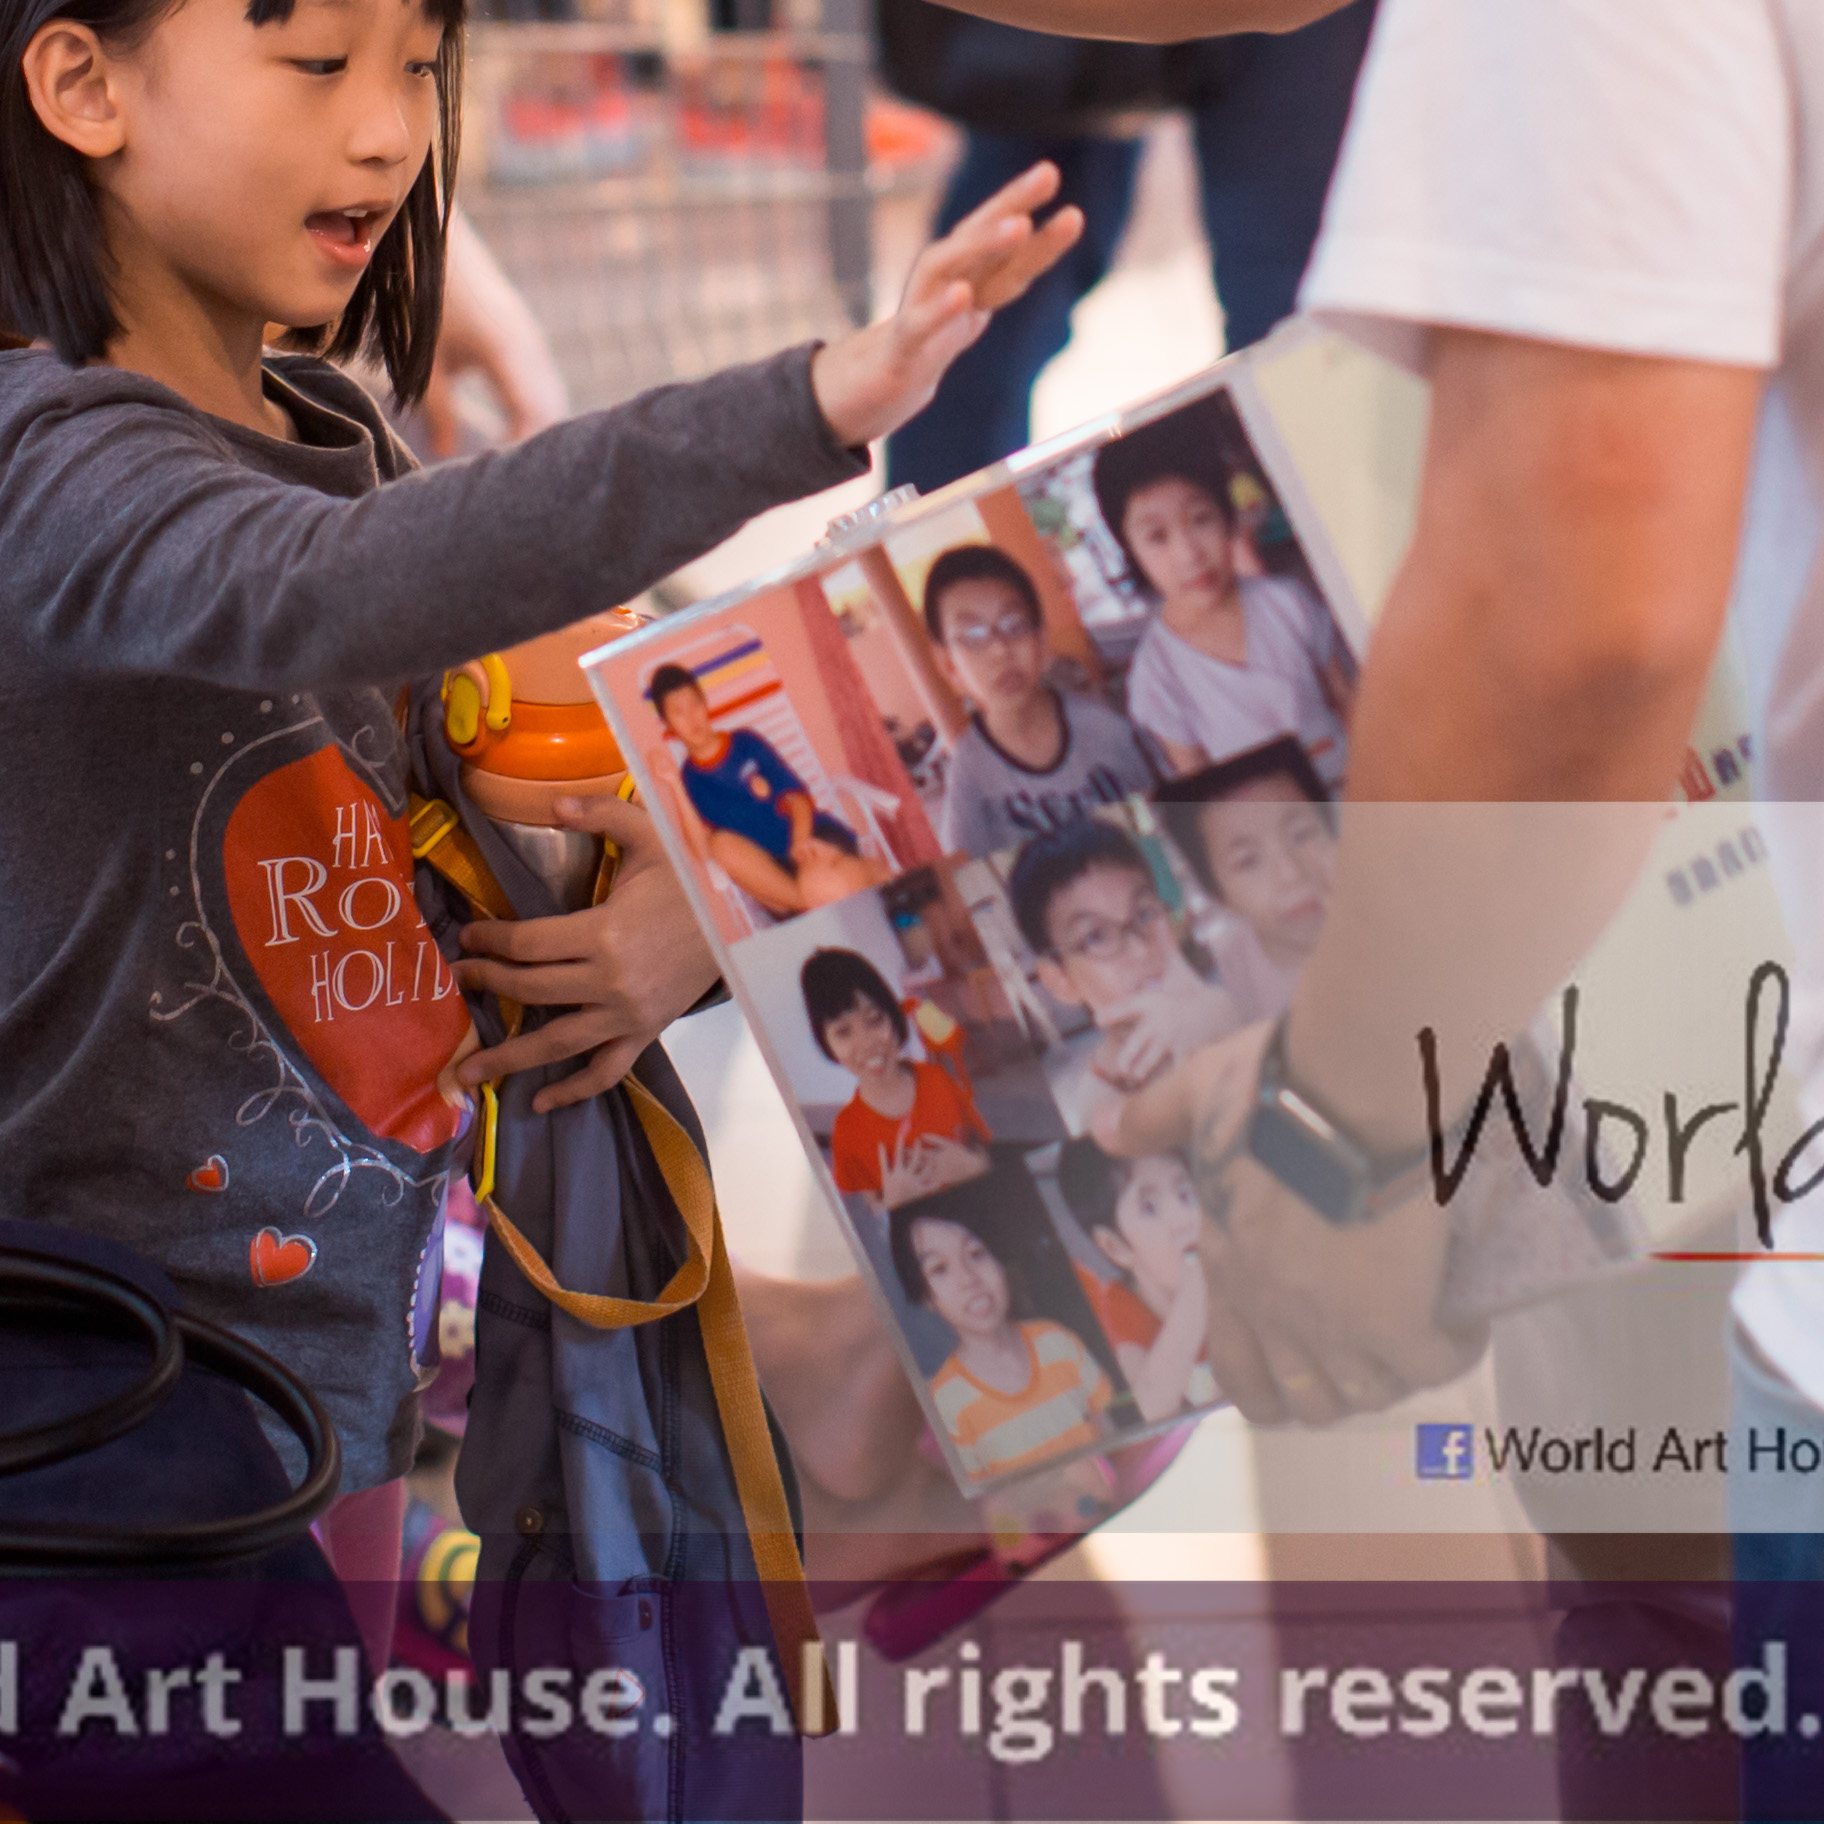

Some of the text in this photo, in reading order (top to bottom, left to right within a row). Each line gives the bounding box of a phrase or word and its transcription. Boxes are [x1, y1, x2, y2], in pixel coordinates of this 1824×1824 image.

[332, 798, 395, 869] HA
[257, 856, 427, 948] RO
[311, 938, 462, 1023] HOLID
